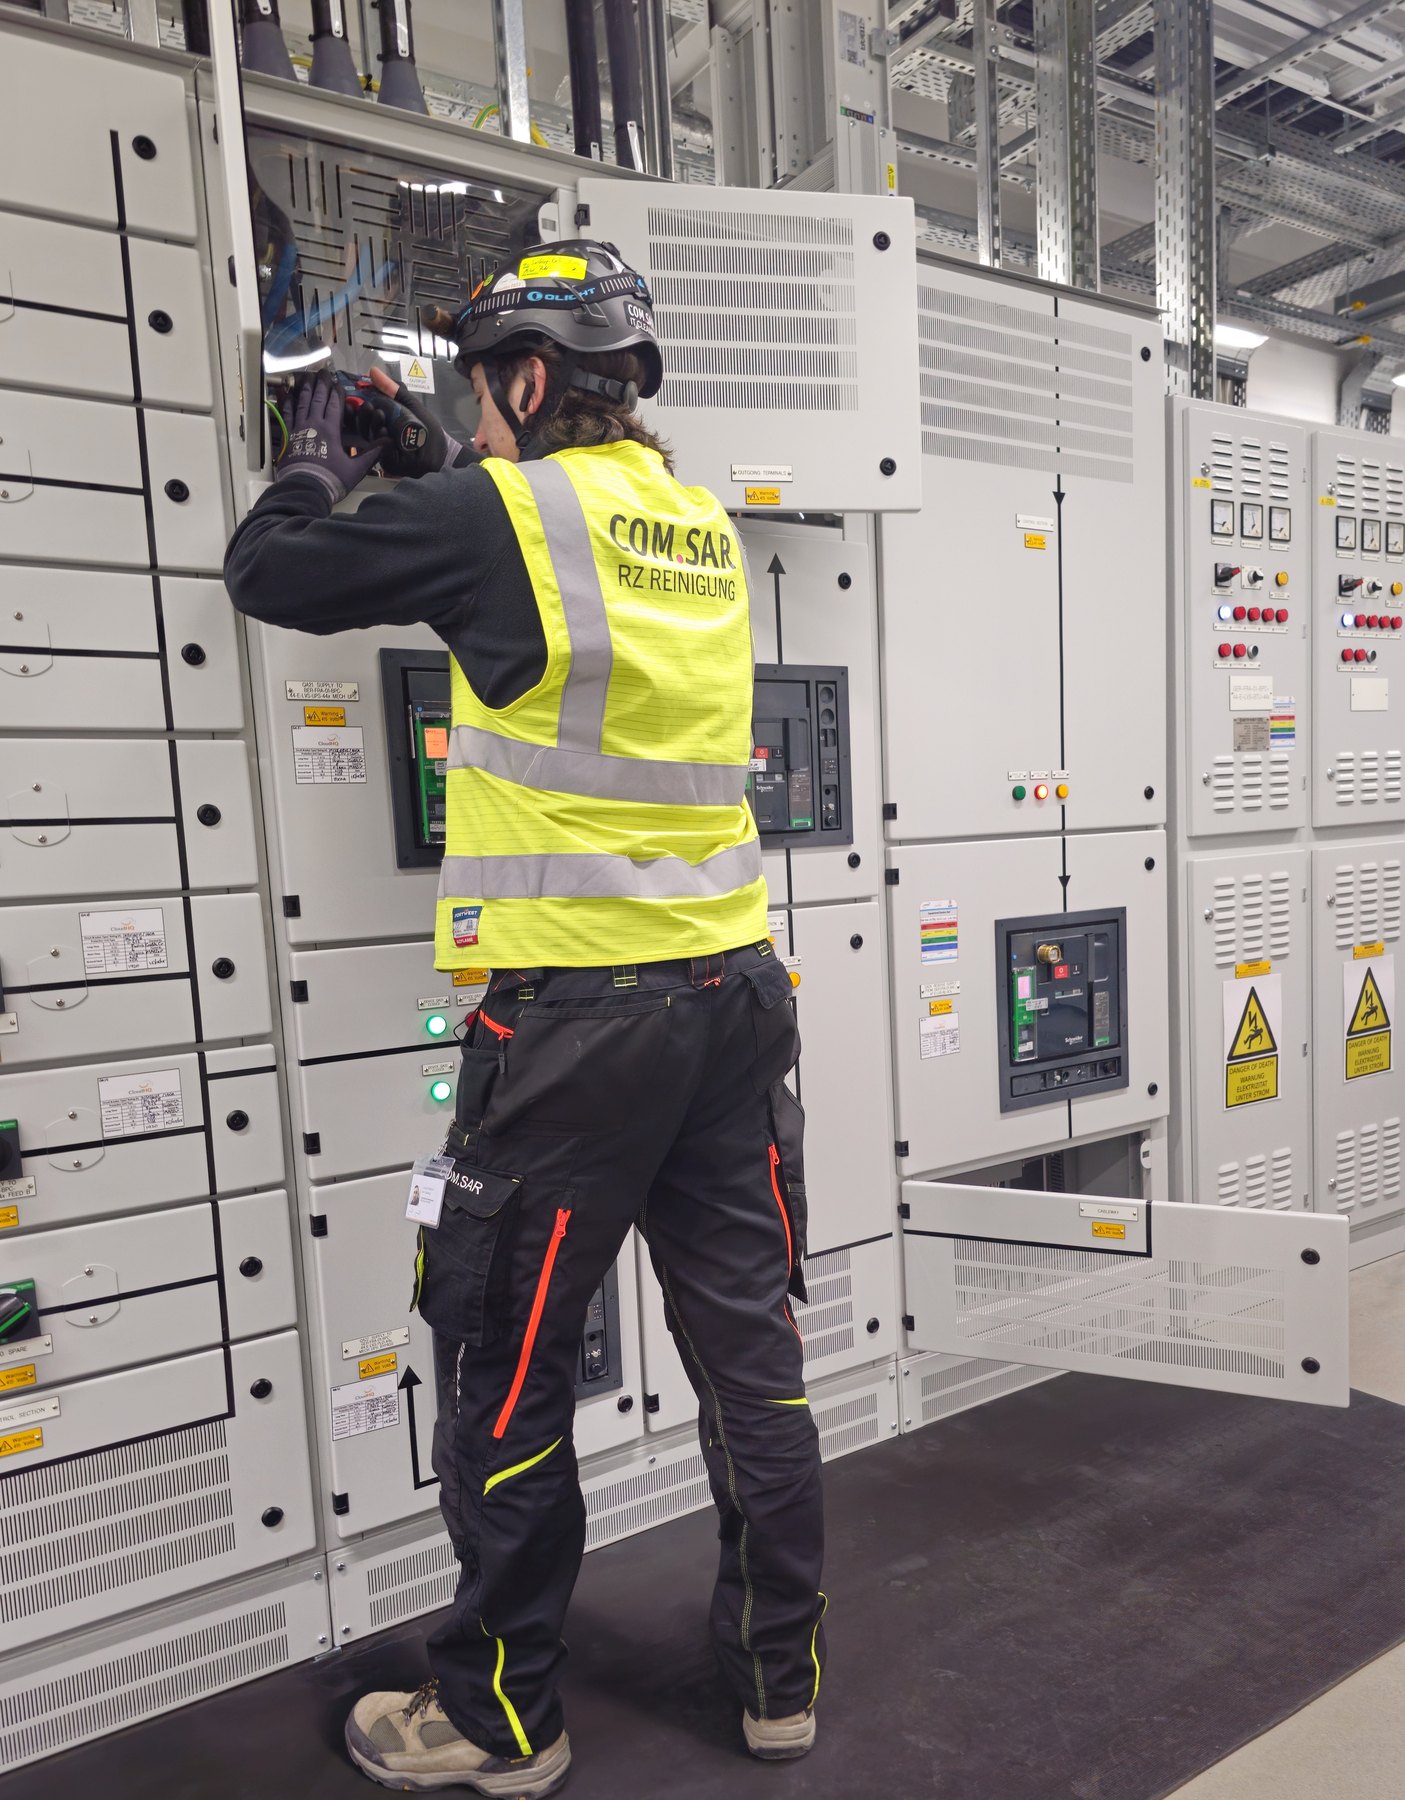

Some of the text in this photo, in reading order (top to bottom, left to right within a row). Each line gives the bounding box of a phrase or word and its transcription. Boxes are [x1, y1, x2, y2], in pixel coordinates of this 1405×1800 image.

[544, 287, 596, 301] OLIGHT
[409, 428, 417, 445] 12V
[609, 513, 737, 570] COM.SAR
[618, 564, 736, 601] RZ REINIGUNG
[1348, 1035, 1388, 1049] DANGER OF DEATH
[1357, 1046, 1380, 1057] WARNUNG
[1229, 1060, 1274, 1075] DANGER OF DEATH
[1353, 1061, 1384, 1074] UNTER STROM
[1239, 1072, 1265, 1084] WARNUNG
[1235, 1088, 1270, 1102] UNTER STROM
[446, 1170, 483, 1195] OM.SAR
[8, 1345, 28, 1355] SPARE
[18, 1406, 46, 1418] SECTION
